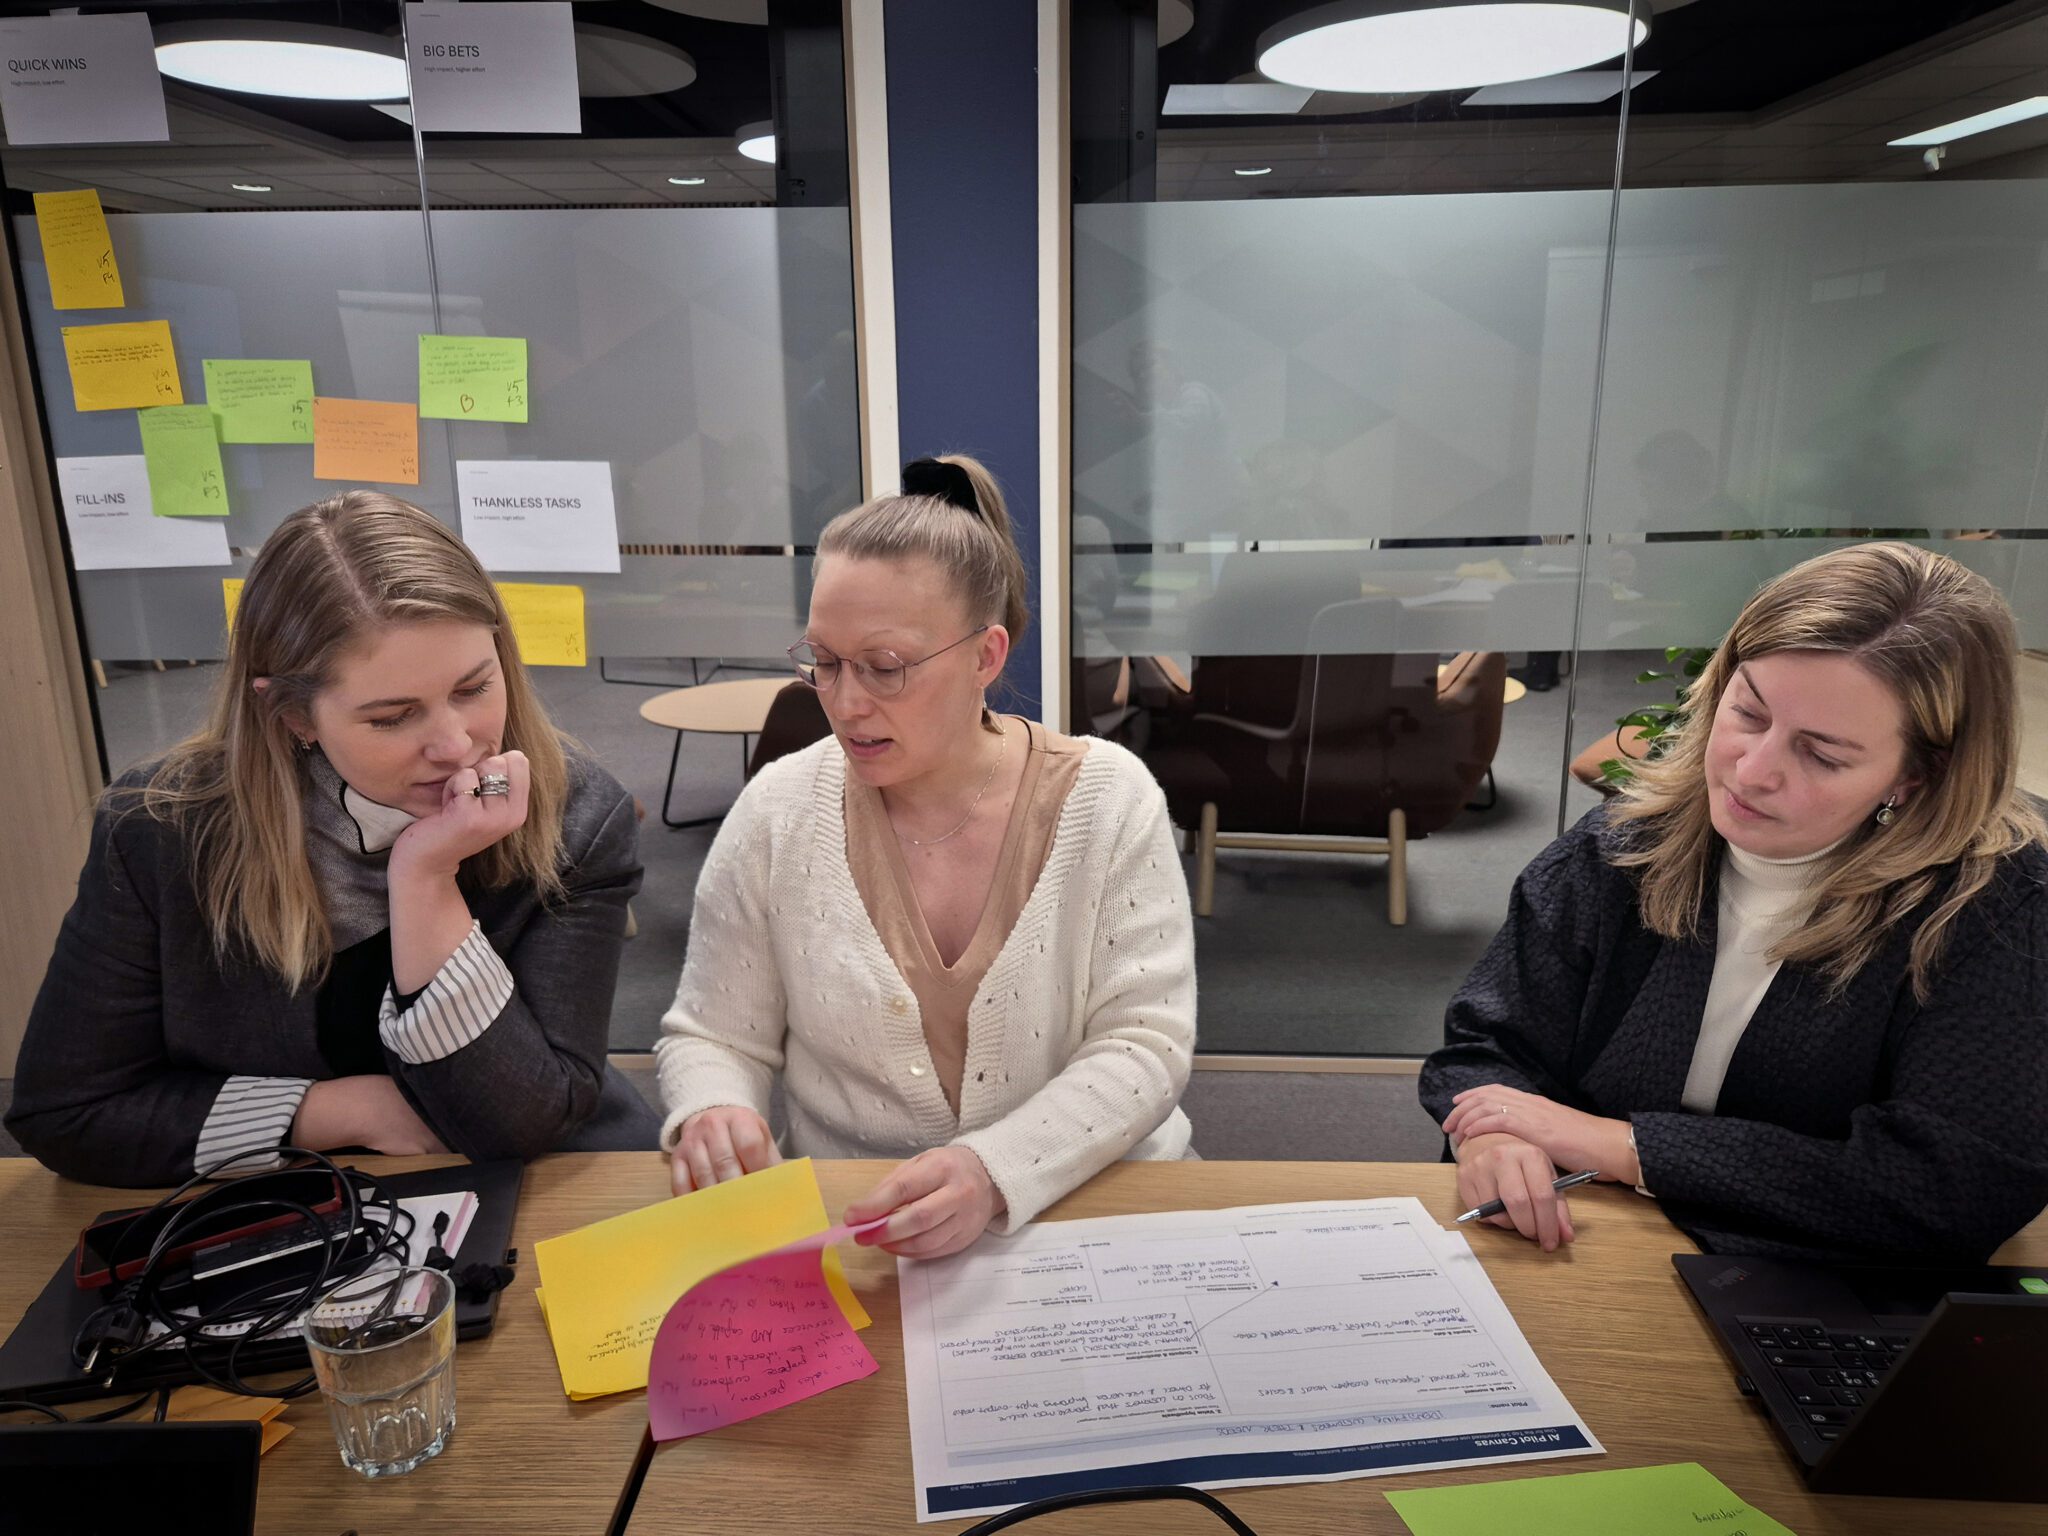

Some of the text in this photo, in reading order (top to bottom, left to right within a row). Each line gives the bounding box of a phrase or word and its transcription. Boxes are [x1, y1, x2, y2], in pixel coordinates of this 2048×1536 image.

[423, 45, 480, 58] BIG BETS
[8, 57, 87, 74] QUICK WINS
[76, 492, 126, 505] FILL-INS
[472, 496, 582, 509] THANKLESS TASKS
[750, 1328, 772, 1344] AND
[726, 1352, 778, 1370] interested
[692, 1375, 750, 1393] customers
[1097, 1402, 1120, 1411] that
[1474, 1433, 1560, 1447] AI Pilot Canvas
